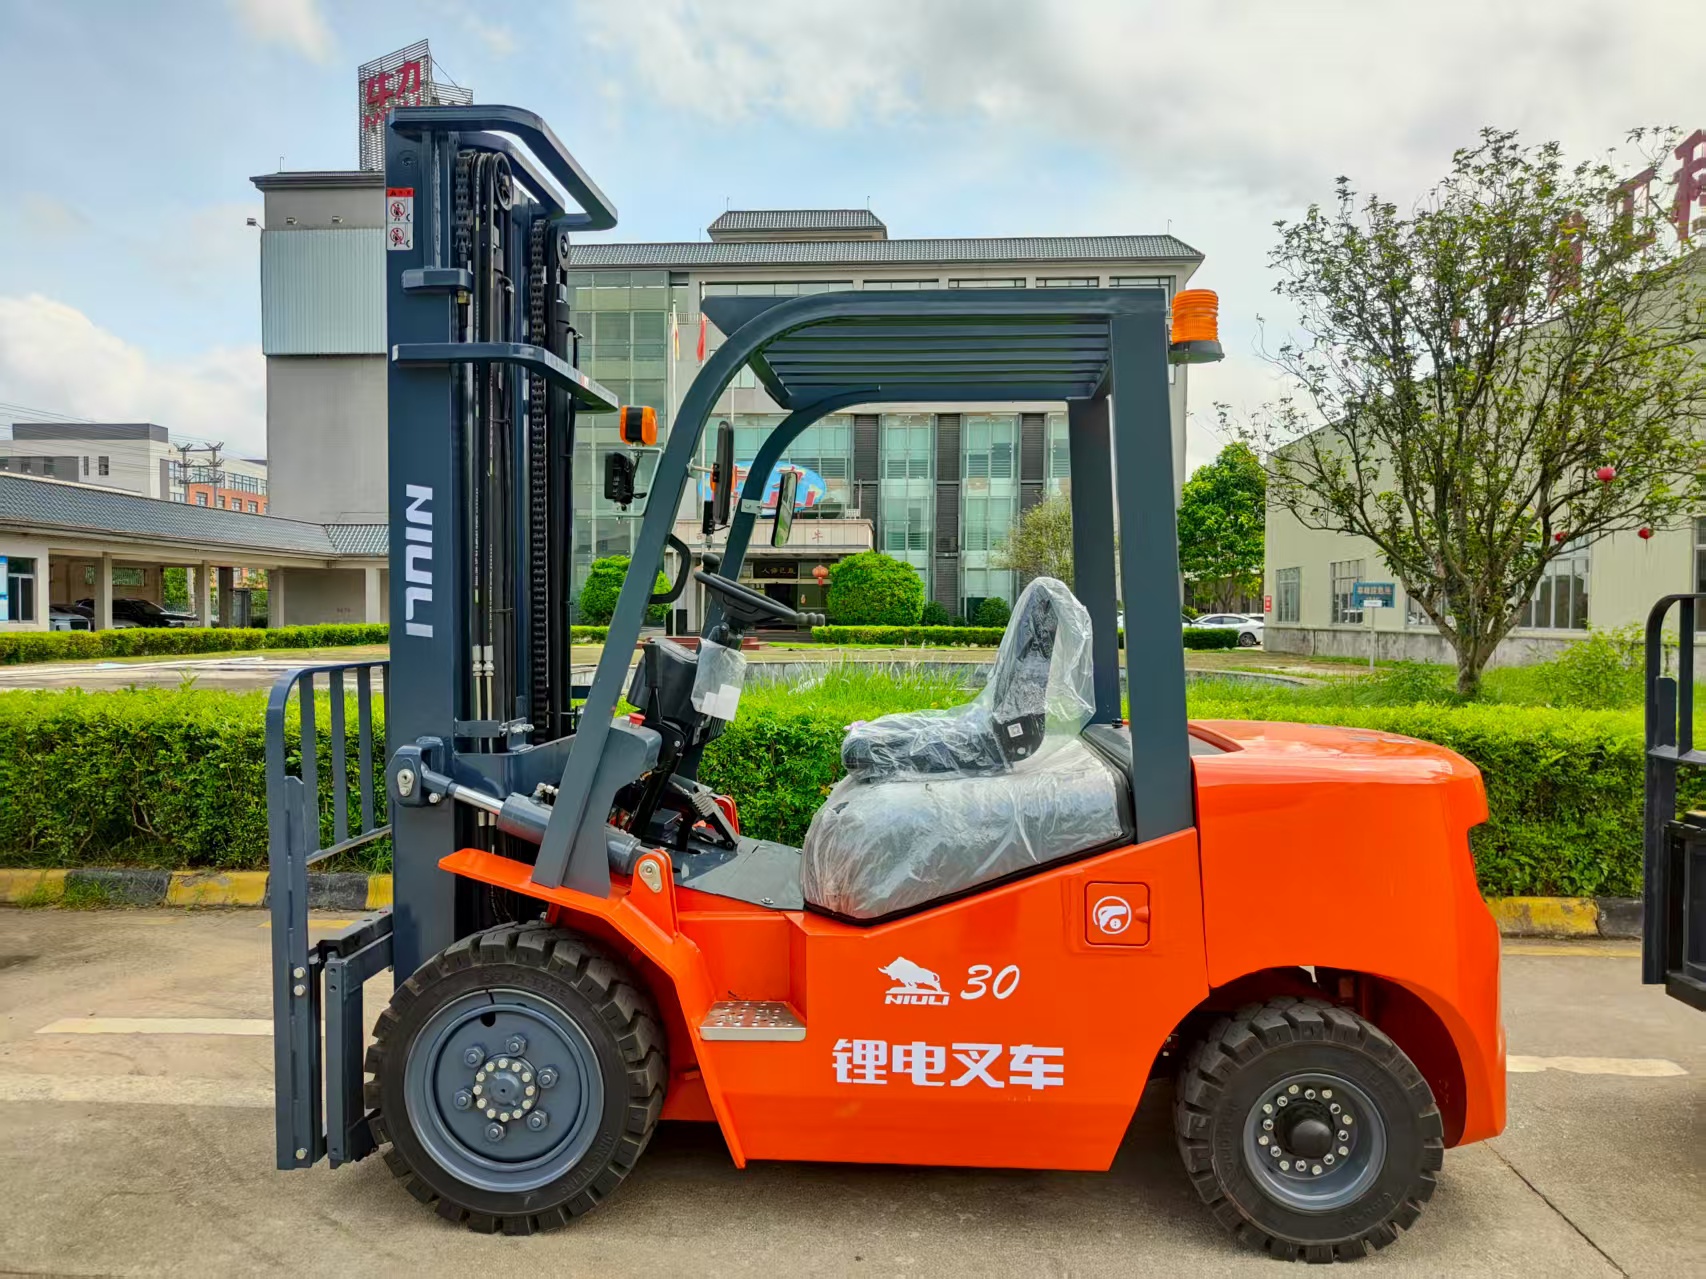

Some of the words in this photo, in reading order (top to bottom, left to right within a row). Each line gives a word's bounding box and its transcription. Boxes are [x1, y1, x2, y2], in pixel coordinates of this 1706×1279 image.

[366, 60, 421, 107] 牛力
[405, 483, 434, 638] NIULI
[884, 994, 950, 1006] NIULI
[960, 964, 1021, 1001] 30
[832, 1038, 1065, 1090] 锂电叉车
